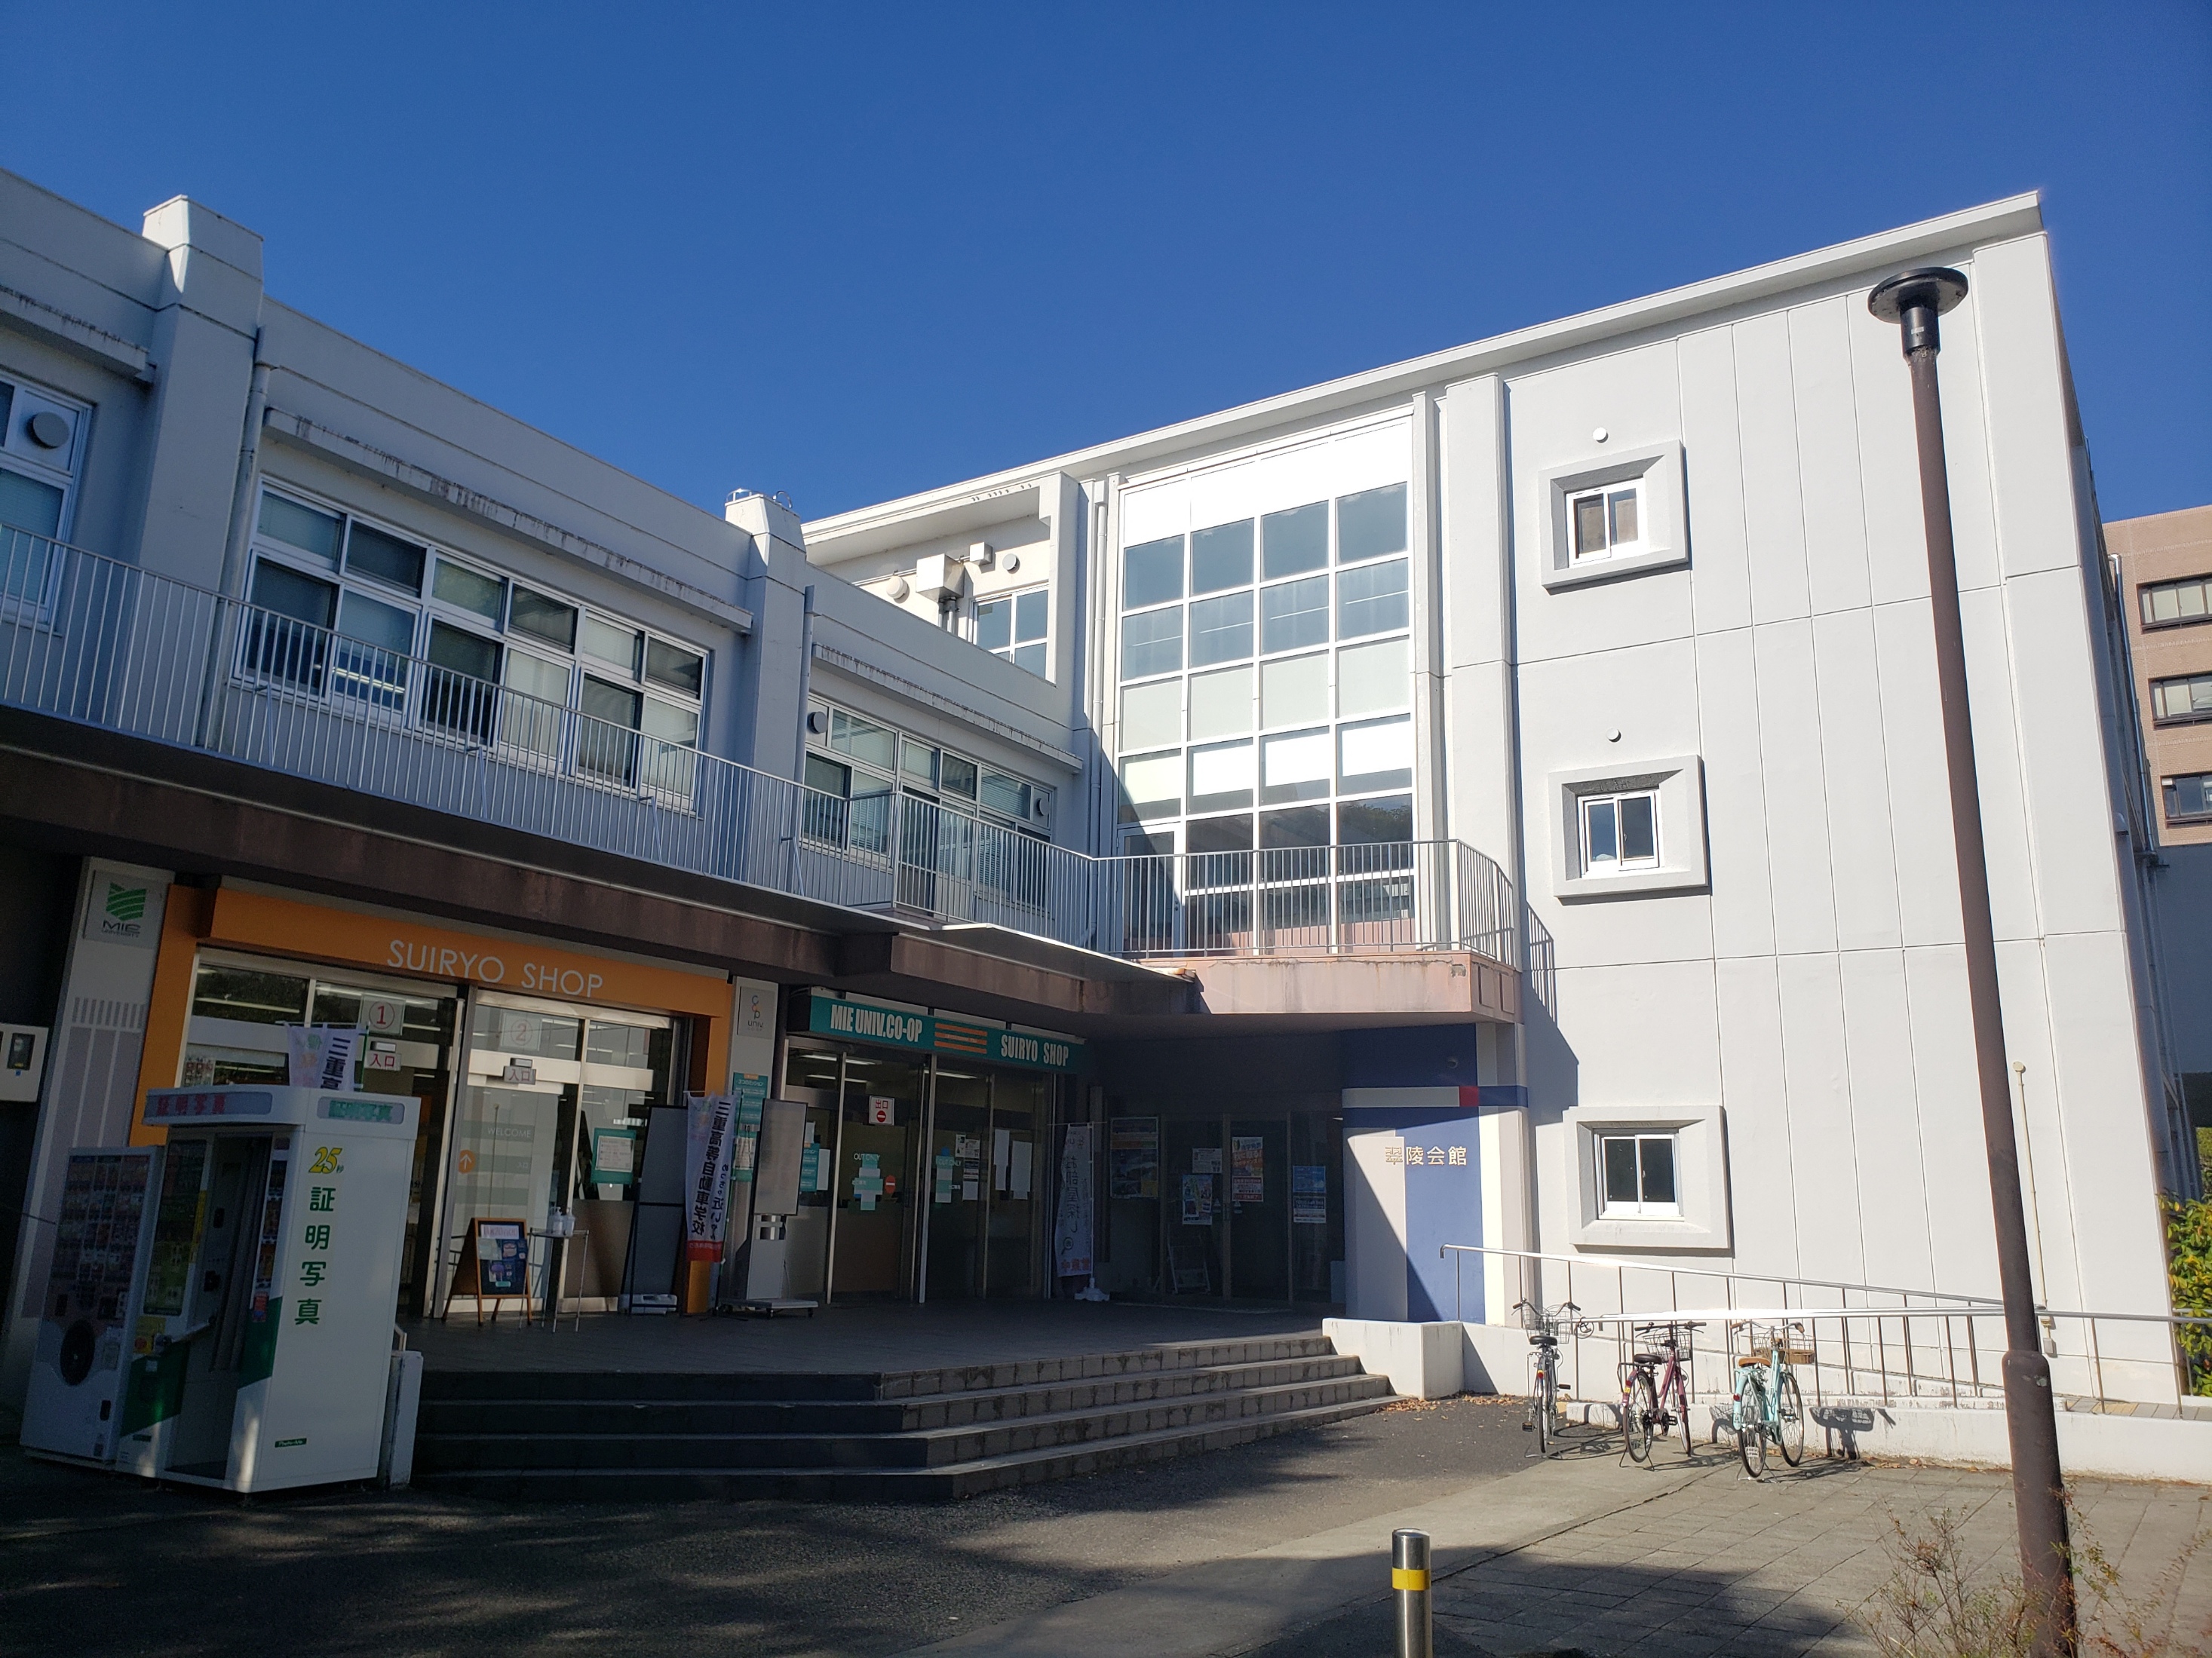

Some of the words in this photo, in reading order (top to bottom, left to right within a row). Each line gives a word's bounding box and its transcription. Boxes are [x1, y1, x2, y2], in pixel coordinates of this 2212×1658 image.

[386, 939, 505, 983] SUIRYO
[521, 962, 603, 998] SHOP
[830, 1004, 854, 1031] MIE
[854, 1008, 923, 1042] UNIV.CO-OP
[369, 1053, 397, 1068] 入口
[1001, 1034, 1039, 1062] SUIRYO
[1043, 1042, 1069, 1067] SHOP
[508, 1068, 531, 1082] 入口
[875, 1099, 888, 1109] 出口
[487, 1126, 532, 1139] WELCOME
[1385, 1145, 1467, 1166] 翠陵会館
[295, 1187, 337, 1325] 証明写真
